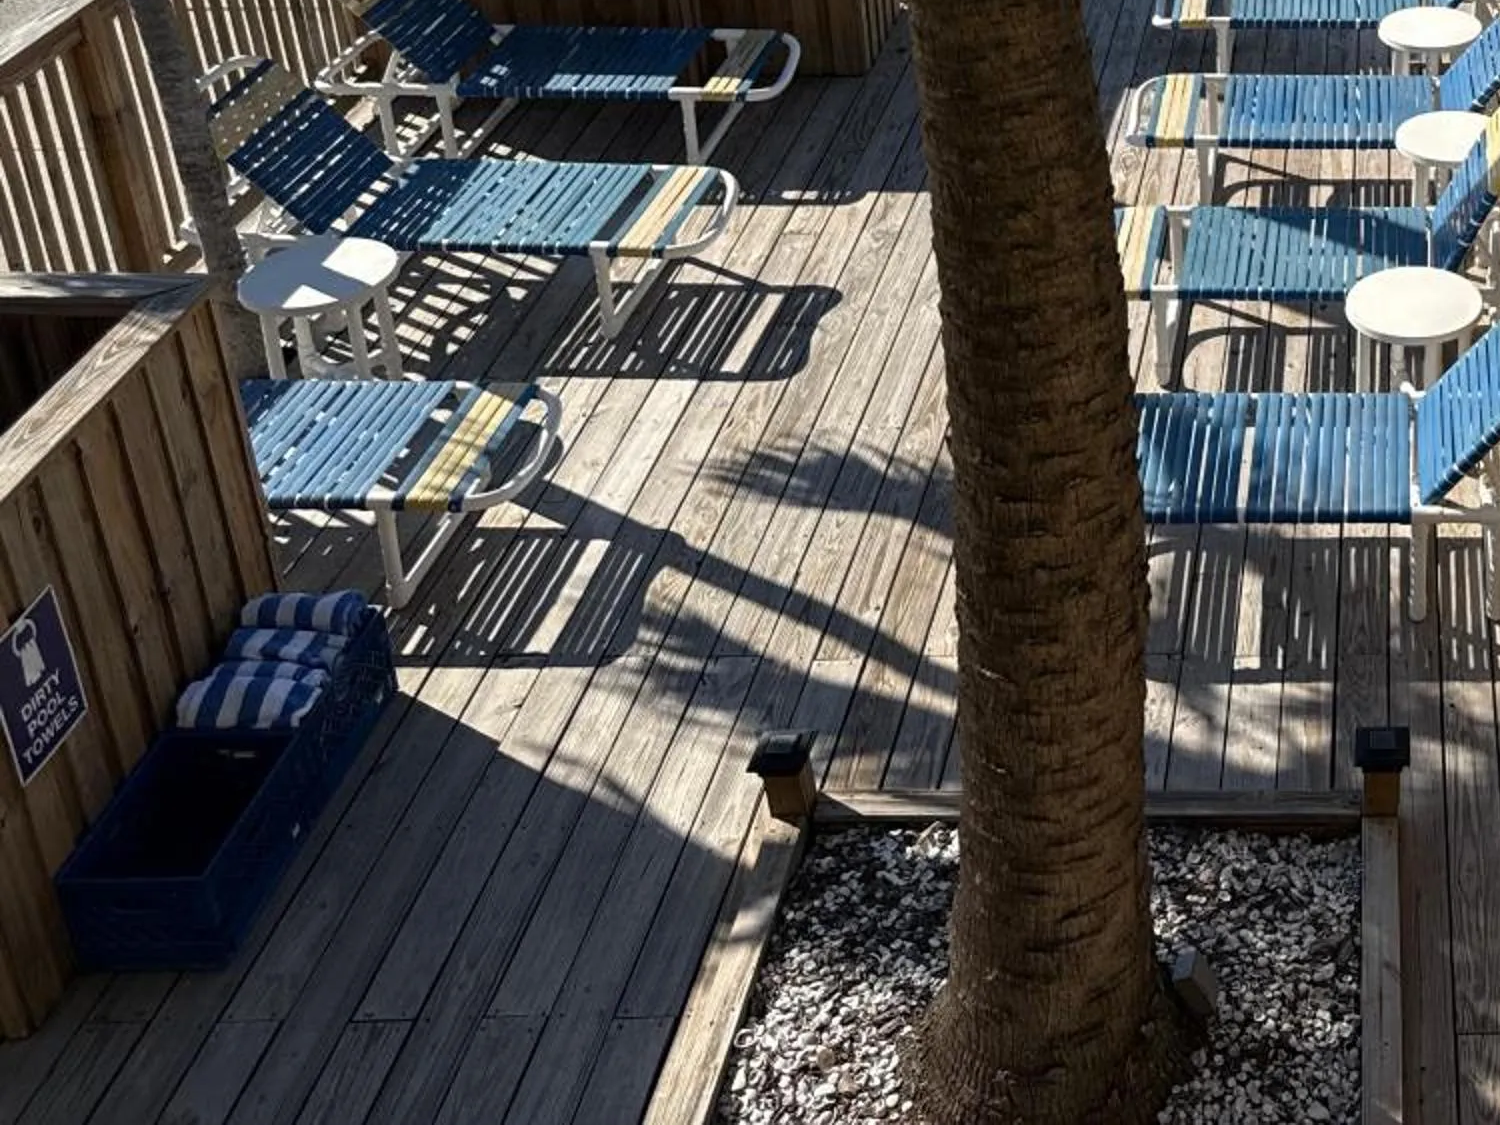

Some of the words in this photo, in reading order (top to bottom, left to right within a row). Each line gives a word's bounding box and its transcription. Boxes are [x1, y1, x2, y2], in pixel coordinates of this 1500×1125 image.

[21, 667, 60, 722] DIRTY
[28, 691, 66, 739] POOL
[21, 695, 79, 764] TOWELS
